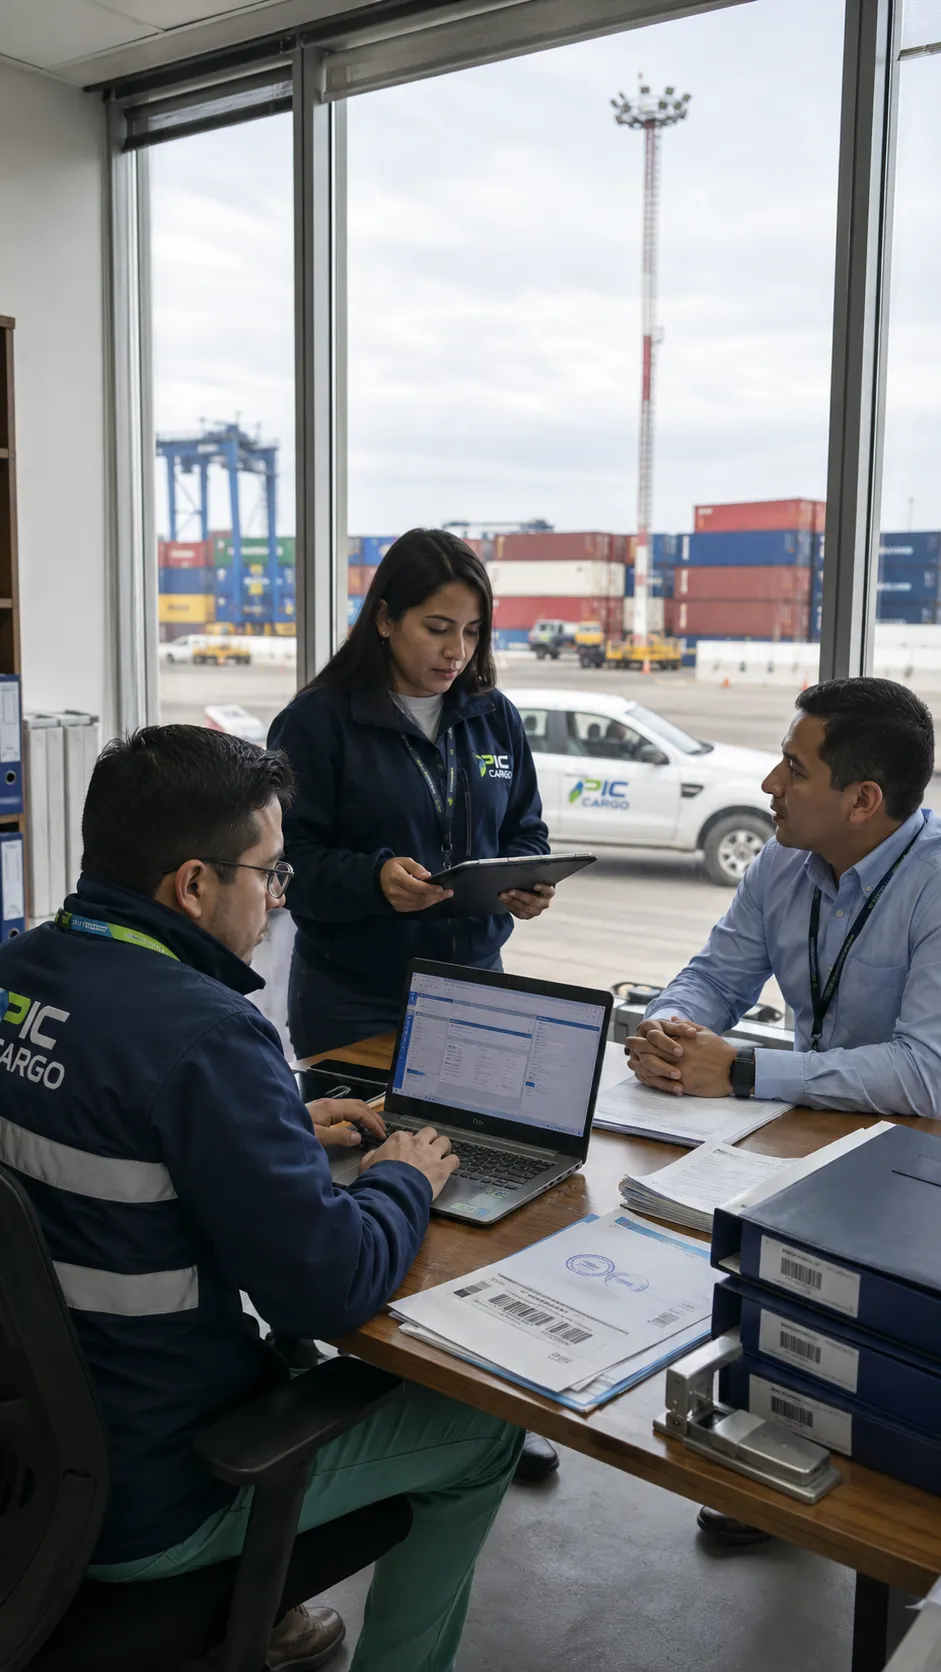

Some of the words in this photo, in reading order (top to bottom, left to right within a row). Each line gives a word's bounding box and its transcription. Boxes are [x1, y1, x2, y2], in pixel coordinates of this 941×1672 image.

[478, 754, 509, 769] PIC
[489, 769, 513, 779] CARGO
[572, 778, 629, 799] PIC
[581, 798, 630, 811] CARGO
[0, 1038, 65, 1090] ARGO
